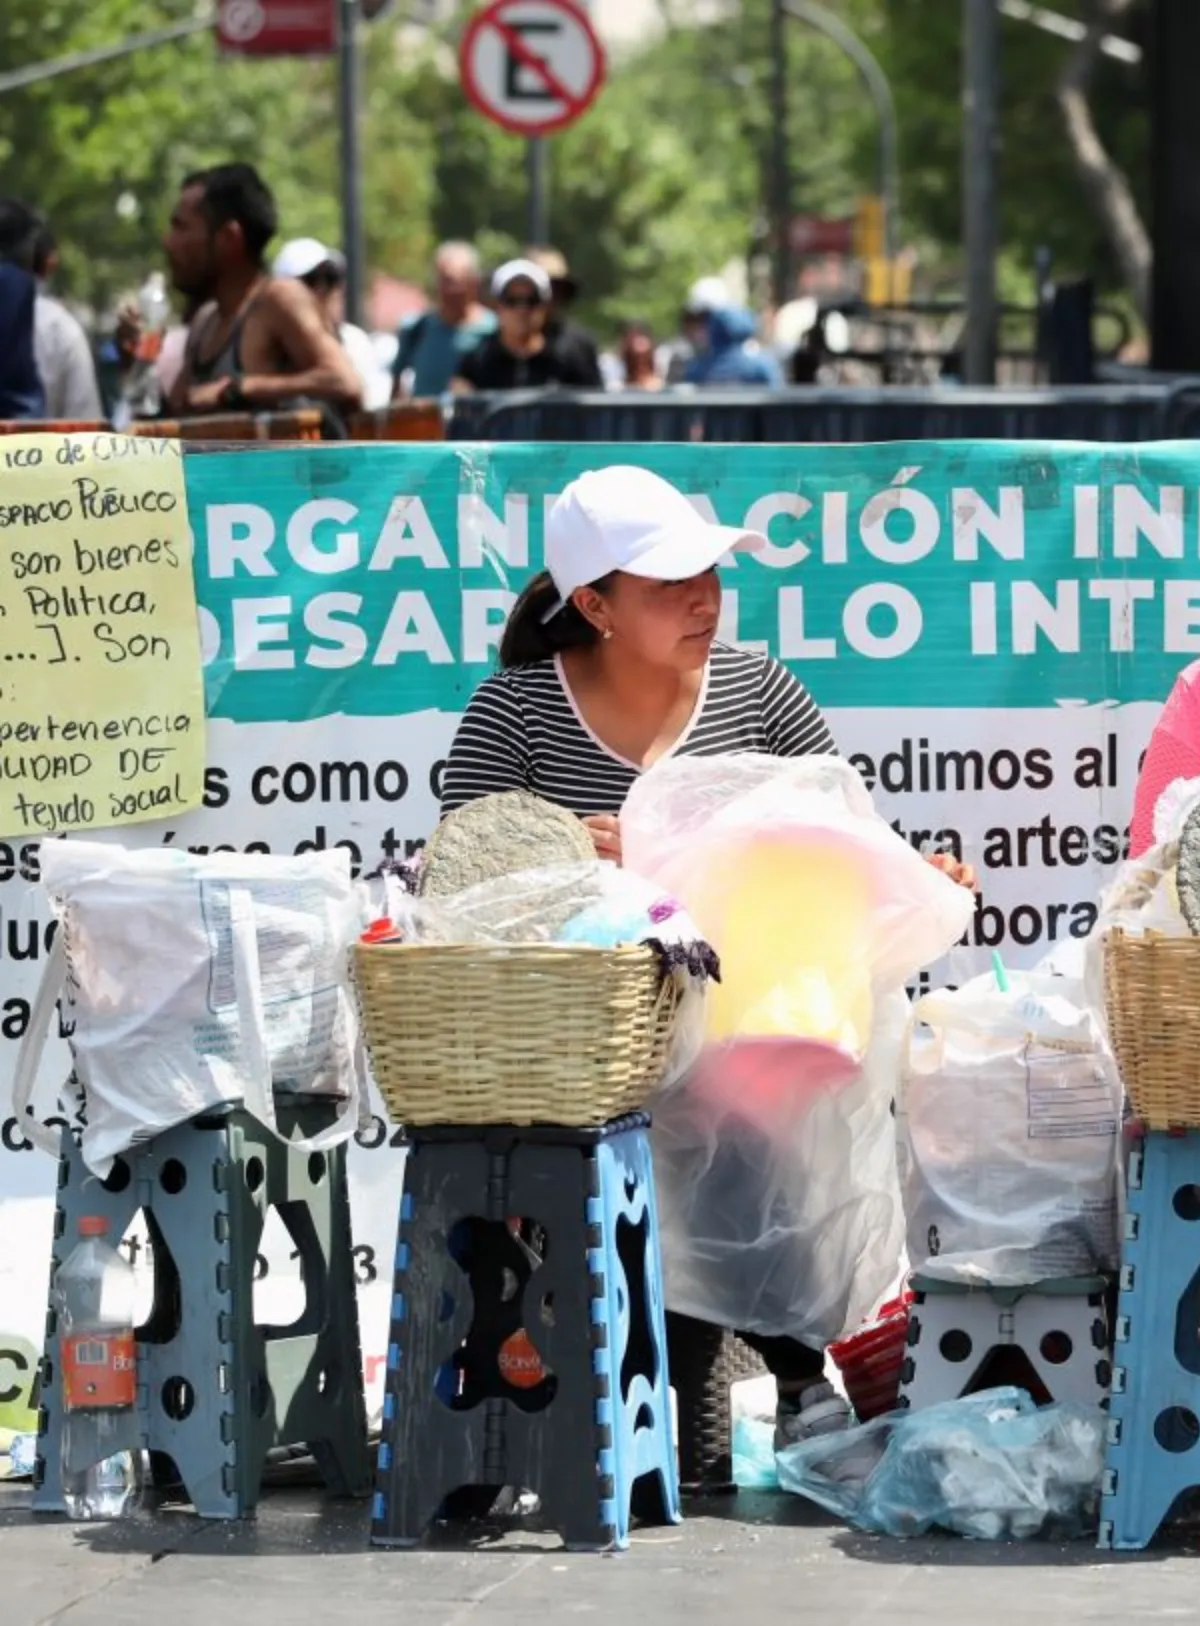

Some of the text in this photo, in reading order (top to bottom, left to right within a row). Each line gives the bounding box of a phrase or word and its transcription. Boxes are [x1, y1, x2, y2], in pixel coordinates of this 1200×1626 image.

[56, 438, 85, 465] de
[11, 538, 179, 579] son bienes
[93, 623, 171, 663] Son
[119, 747, 176, 780] DE
[252, 759, 408, 806] como
[1074, 733, 1117, 789] al
[14, 773, 187, 831] tejido social
[983, 814, 1130, 868] artes
